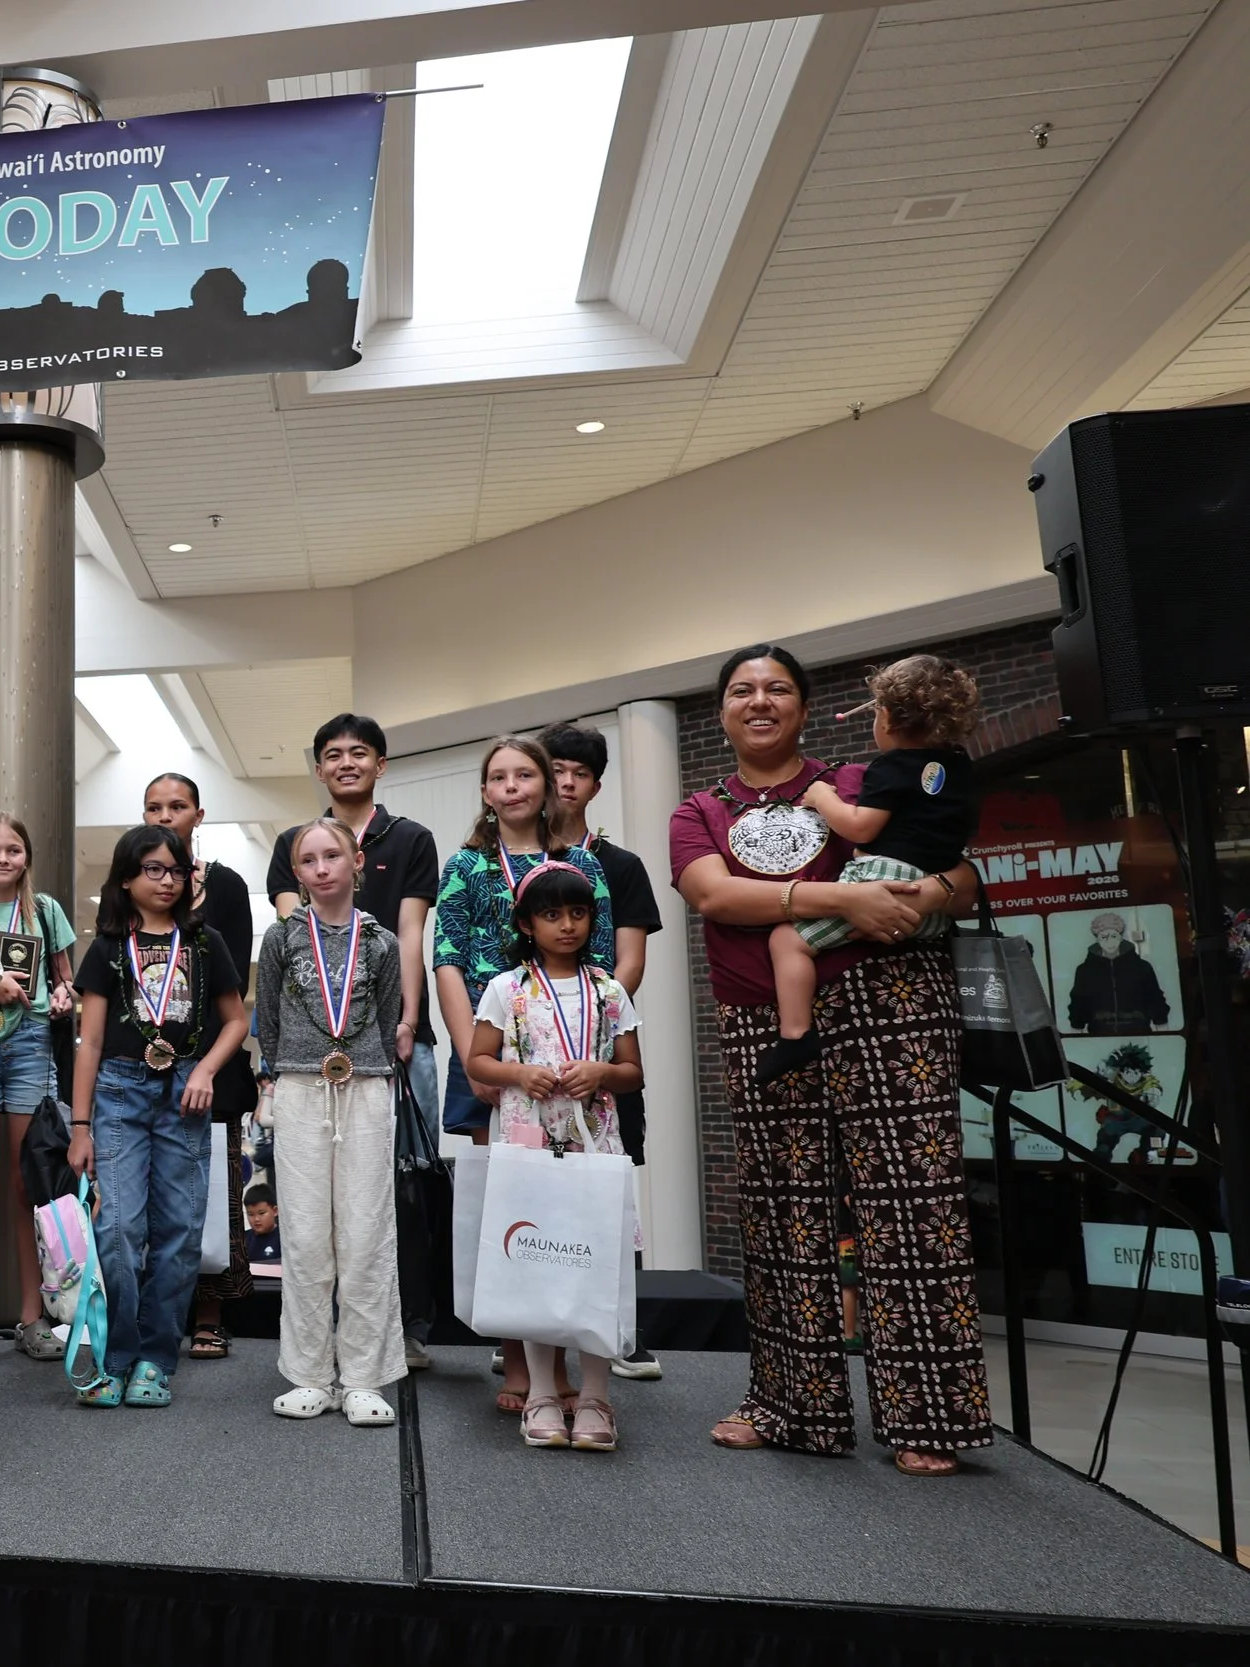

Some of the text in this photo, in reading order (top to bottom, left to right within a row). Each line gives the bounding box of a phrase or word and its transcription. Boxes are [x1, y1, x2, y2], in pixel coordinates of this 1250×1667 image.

[50, 143, 166, 176] Astronomy
[972, 843, 1022, 855] Crunchyroll
[1087, 875, 1119, 885] 2026
[1006, 890, 1128, 908] OVER YOUR FAVORITES
[138, 950, 188, 971] DVENTE
[517, 1236, 592, 1256] MAUNAKEA
[1114, 1247, 1219, 1273] ENTRE STOE
